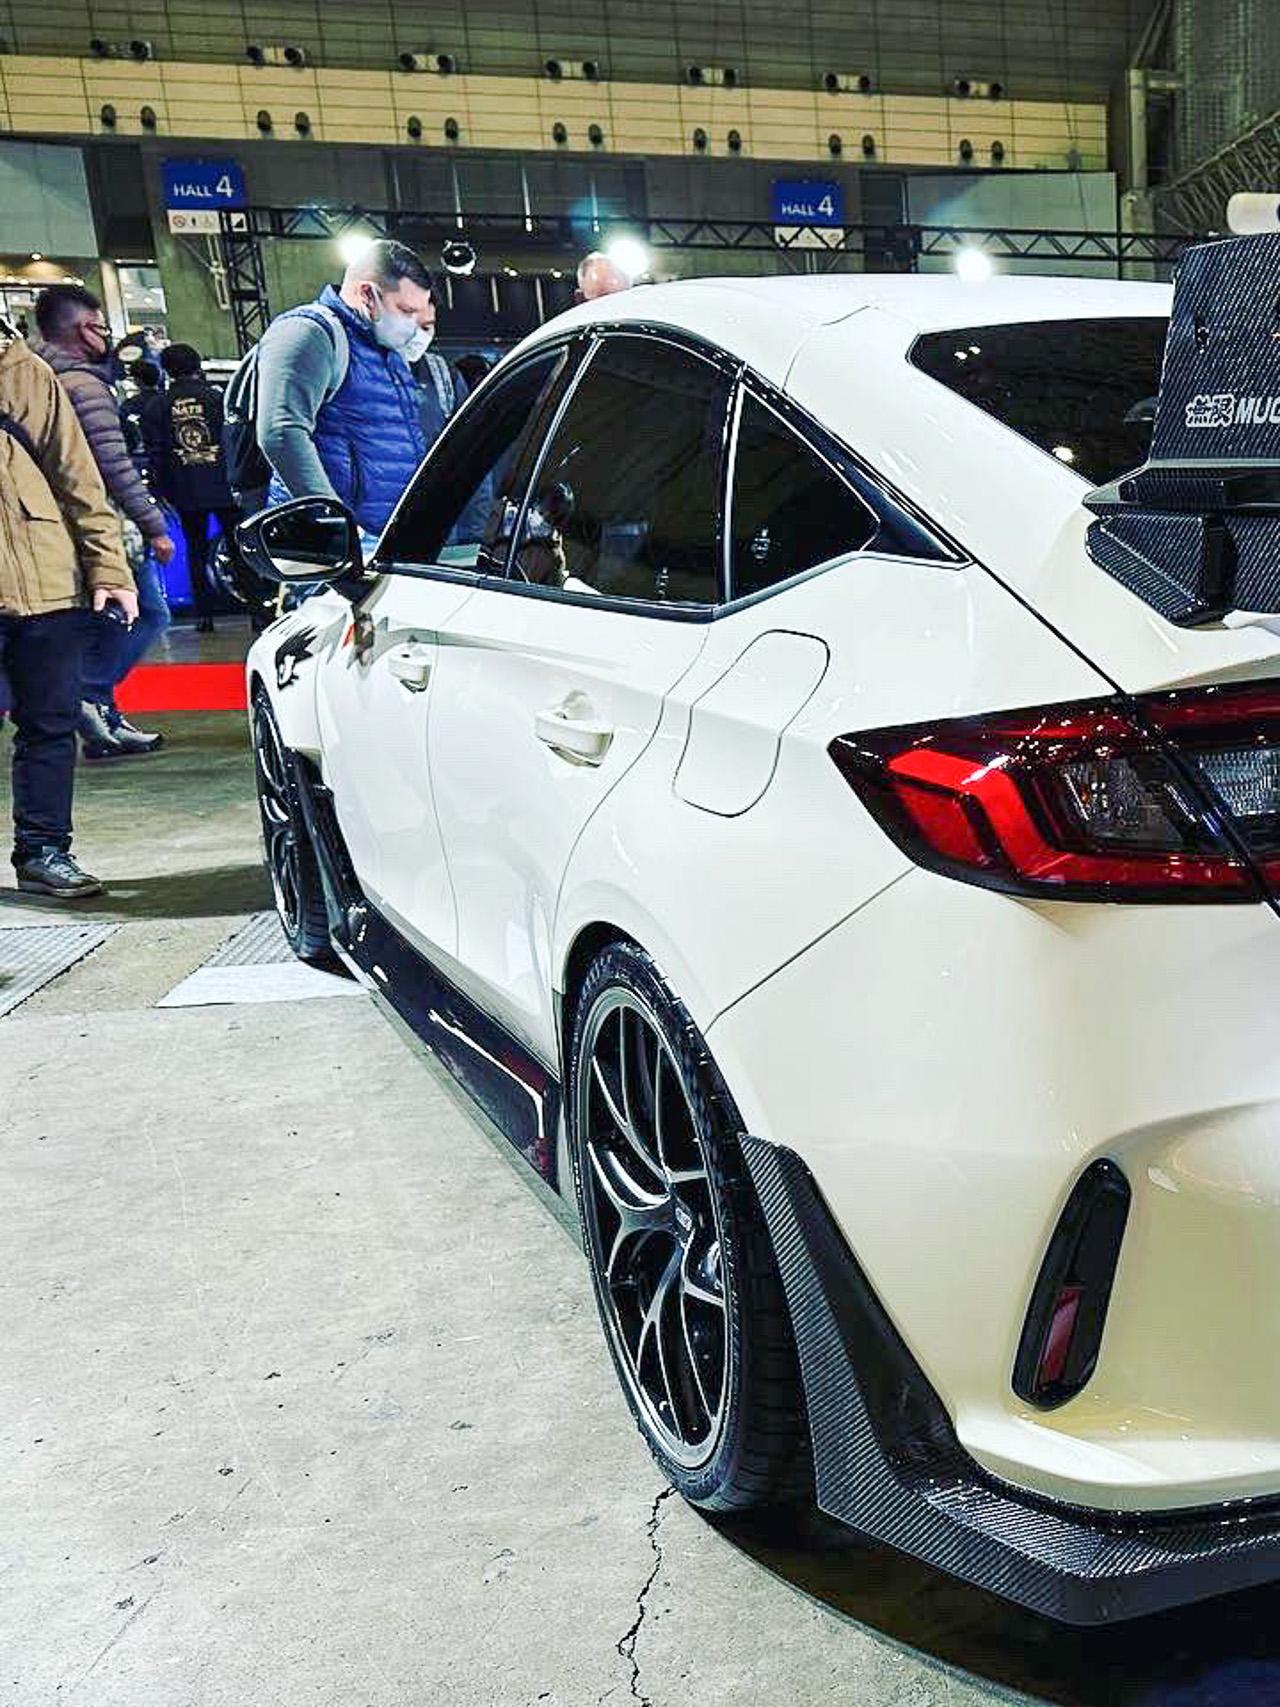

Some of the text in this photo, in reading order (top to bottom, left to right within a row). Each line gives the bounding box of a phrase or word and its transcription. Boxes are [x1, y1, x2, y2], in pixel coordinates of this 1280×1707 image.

[173, 175, 234, 198] HALL 4
[781, 195, 834, 217] HALL 4
